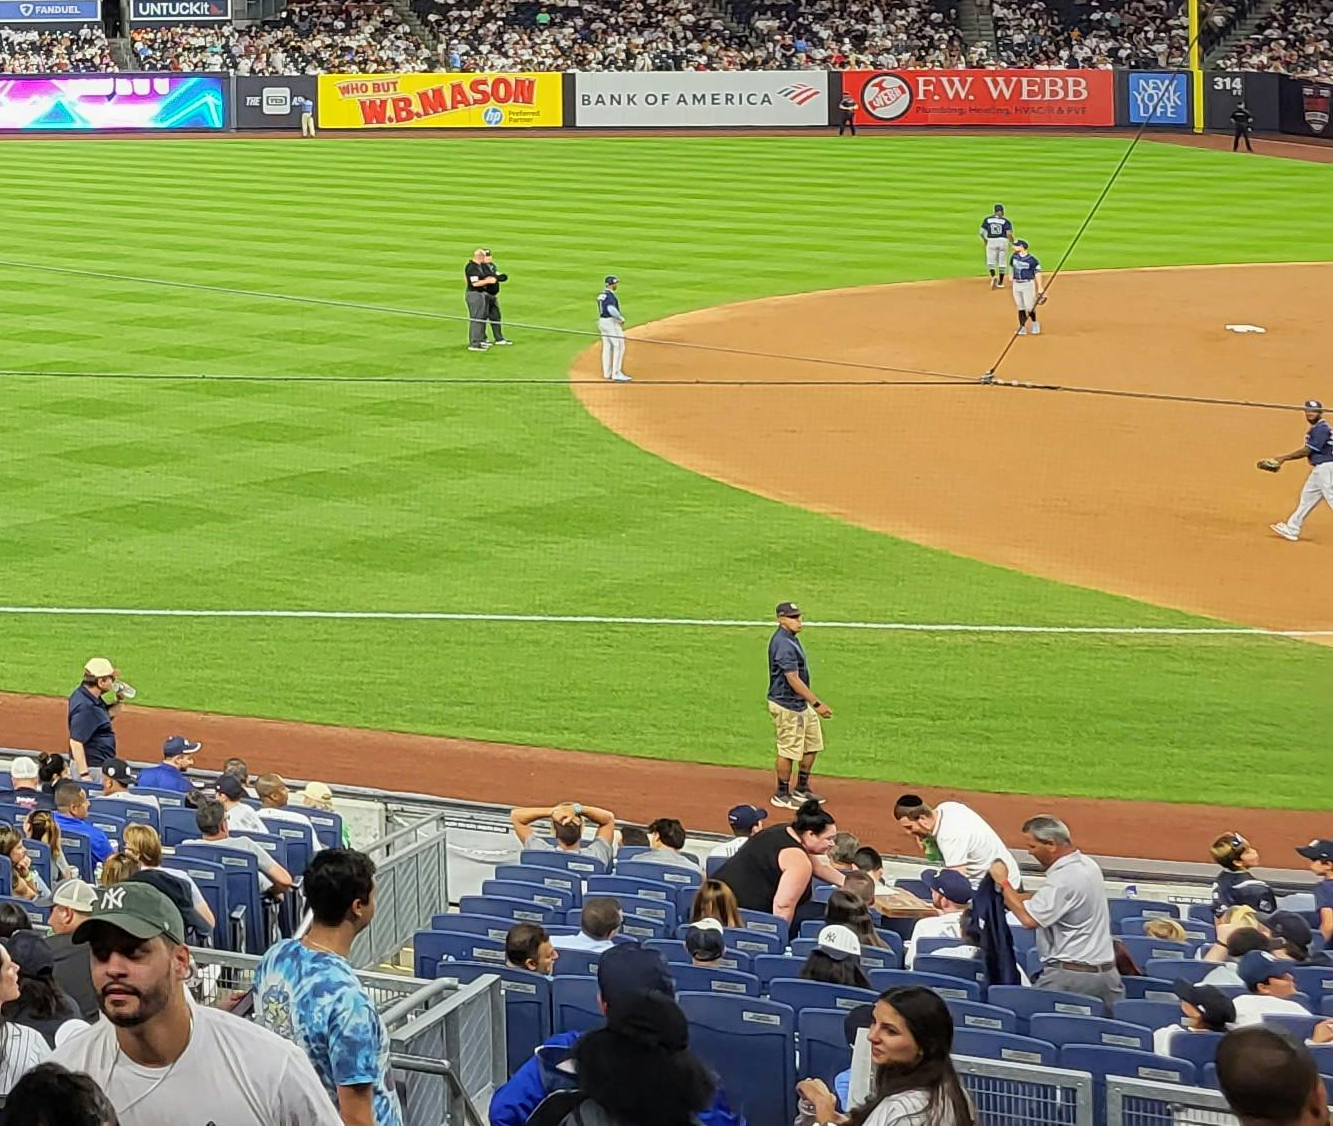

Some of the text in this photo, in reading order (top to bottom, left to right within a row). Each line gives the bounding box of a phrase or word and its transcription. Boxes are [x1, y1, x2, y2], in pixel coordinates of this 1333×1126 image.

[35, 5, 81, 15] FANDUEL
[138, 1, 210, 16] UNTUCKit
[338, 81, 398, 96] WHO BUT
[916, 76, 1089, 100] F.W. WEBB
[1213, 76, 1242, 90] 314
[245, 96, 261, 106] THE
[581, 92, 772, 106] BANK OF AMERICA
[873, 87, 901, 109] WEBB
[484, 109, 502, 125] hp
[100, 886, 126, 910] NY
